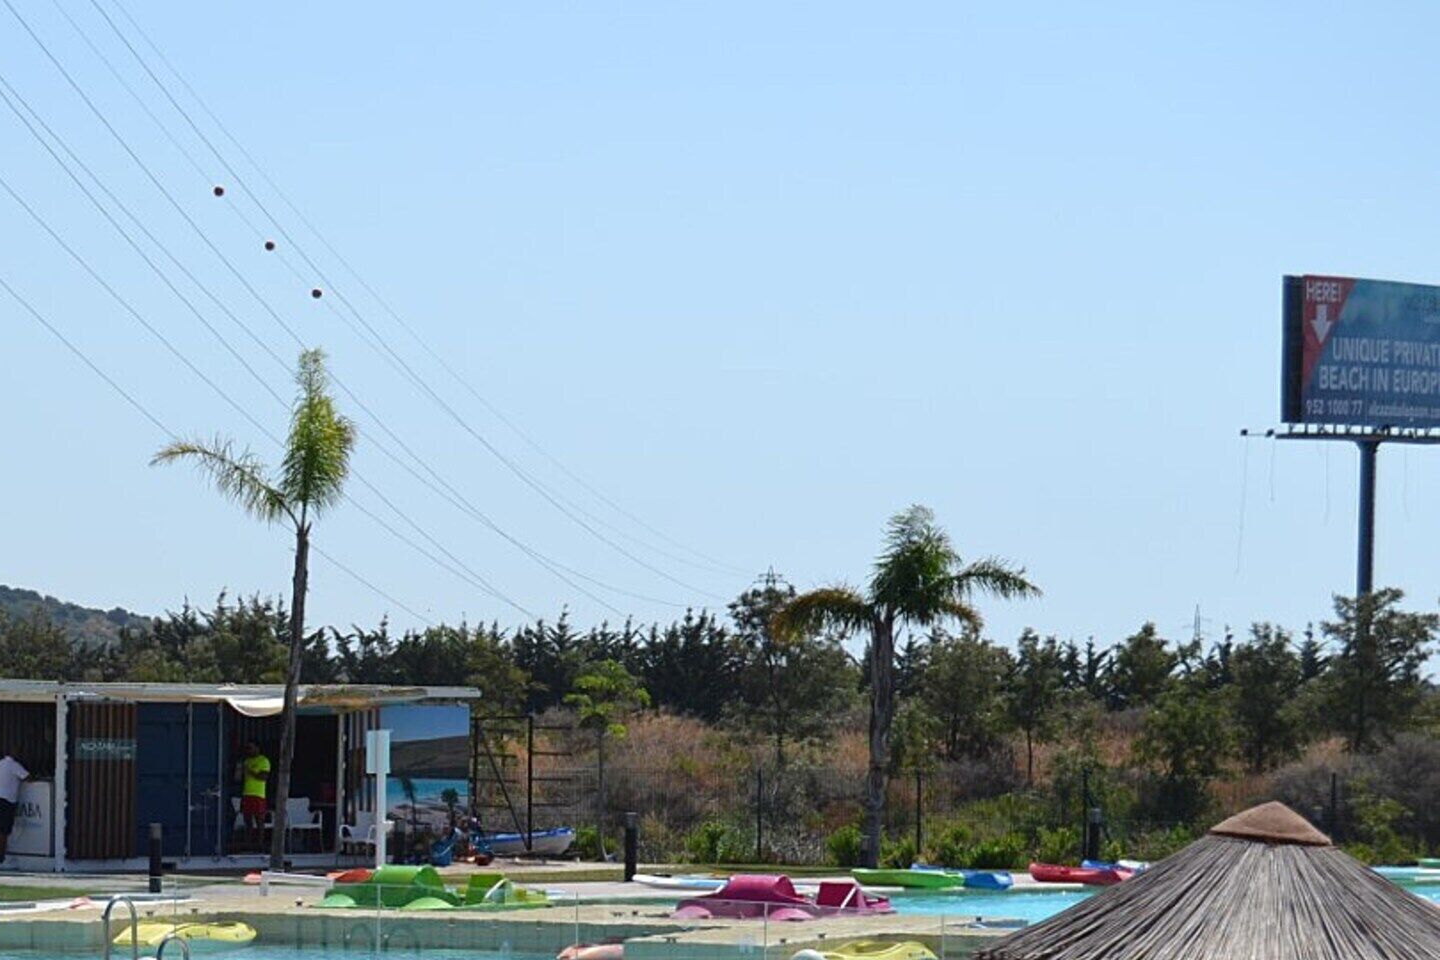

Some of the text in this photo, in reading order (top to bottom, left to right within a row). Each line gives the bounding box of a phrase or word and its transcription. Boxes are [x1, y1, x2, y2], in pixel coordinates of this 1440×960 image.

[1333, 337, 1440, 366] UNIQUE PRIVAT
[1320, 365, 1440, 394] BEACH IN EUROP
